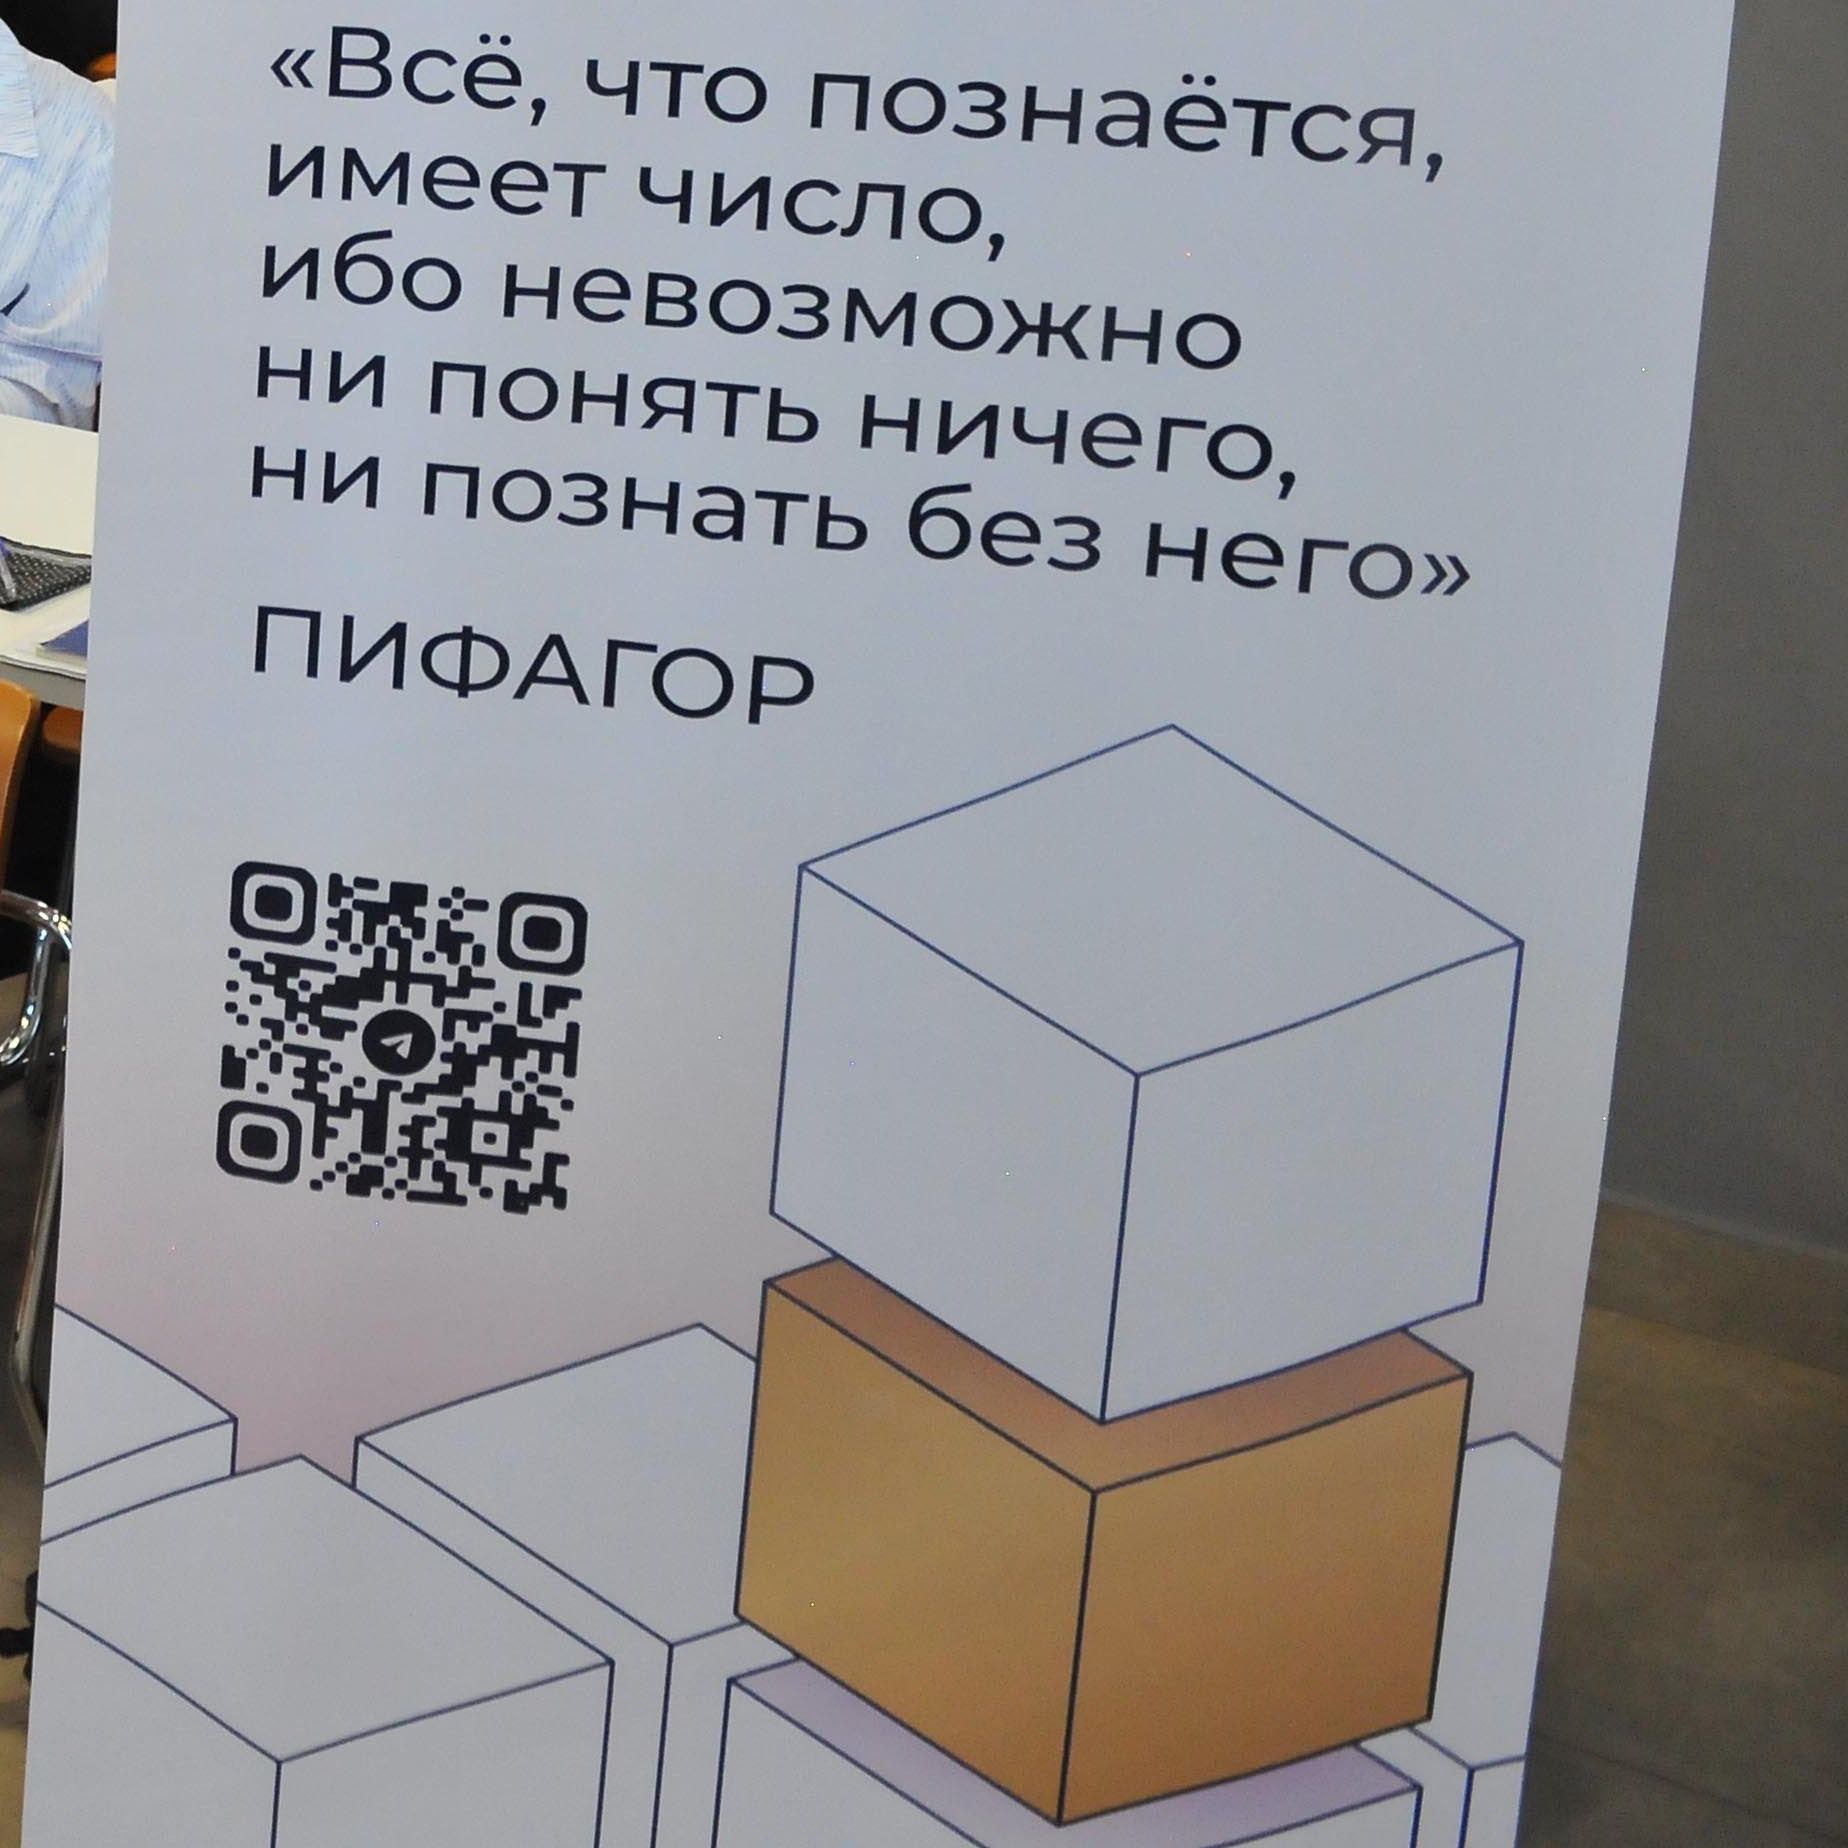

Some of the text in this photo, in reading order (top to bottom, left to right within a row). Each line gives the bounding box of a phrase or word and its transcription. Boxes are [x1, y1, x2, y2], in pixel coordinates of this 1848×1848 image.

[270, 26, 1443, 183] «Всё, что познаётся,
[268, 144, 1005, 262] имеет число,
[263, 229, 1241, 370] ибо невозможно
[257, 346, 1295, 501] ни понять ничего,
[252, 446, 1470, 600] ни познать без него»
[254, 605, 814, 725] ПИФАГОР
